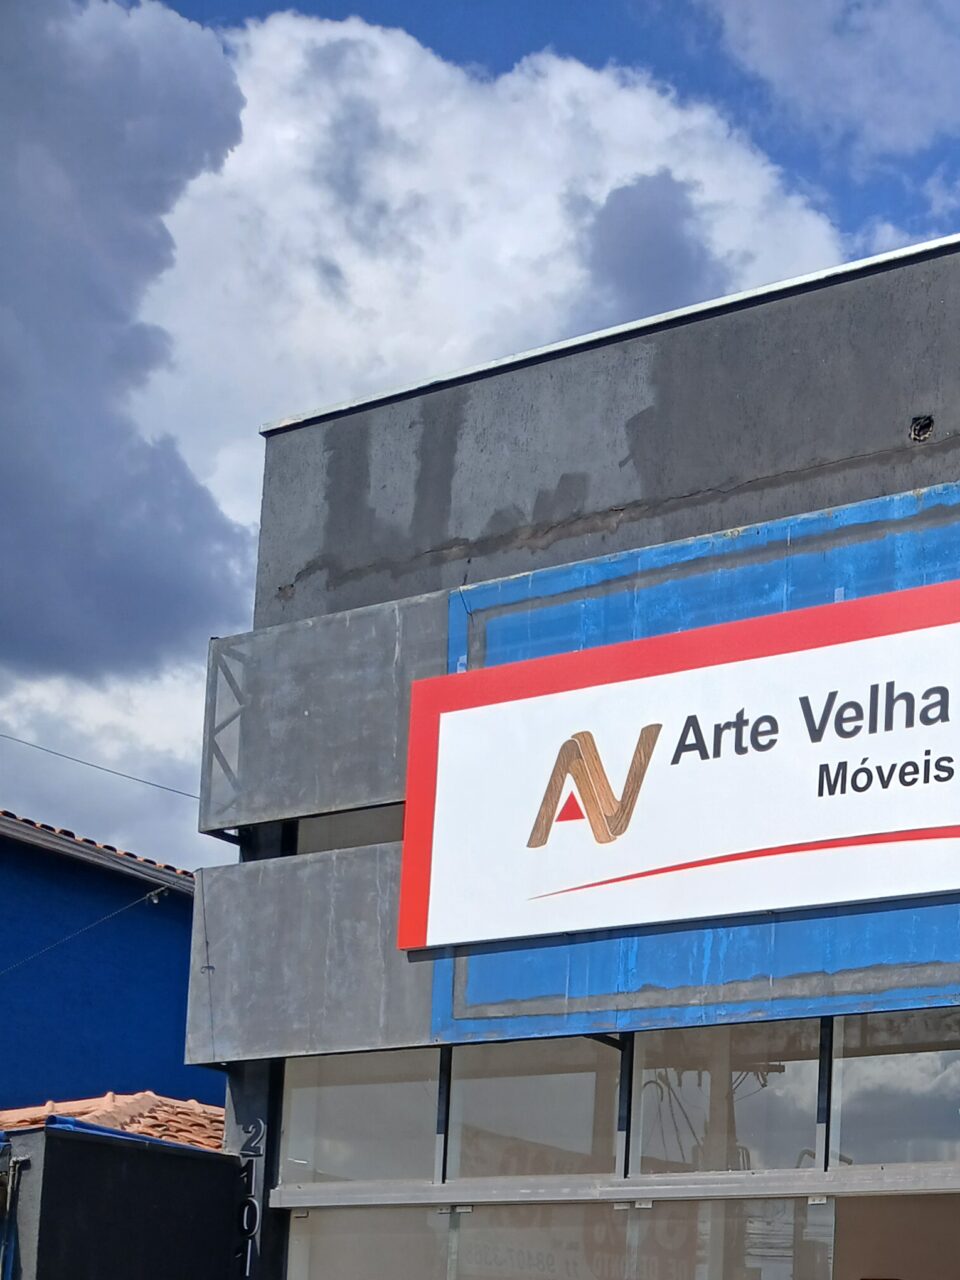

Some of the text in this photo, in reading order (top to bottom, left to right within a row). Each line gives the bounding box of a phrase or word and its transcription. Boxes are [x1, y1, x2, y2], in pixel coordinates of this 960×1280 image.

[670, 681, 951, 766] Arte Velha
[817, 749, 955, 798] Móveis
